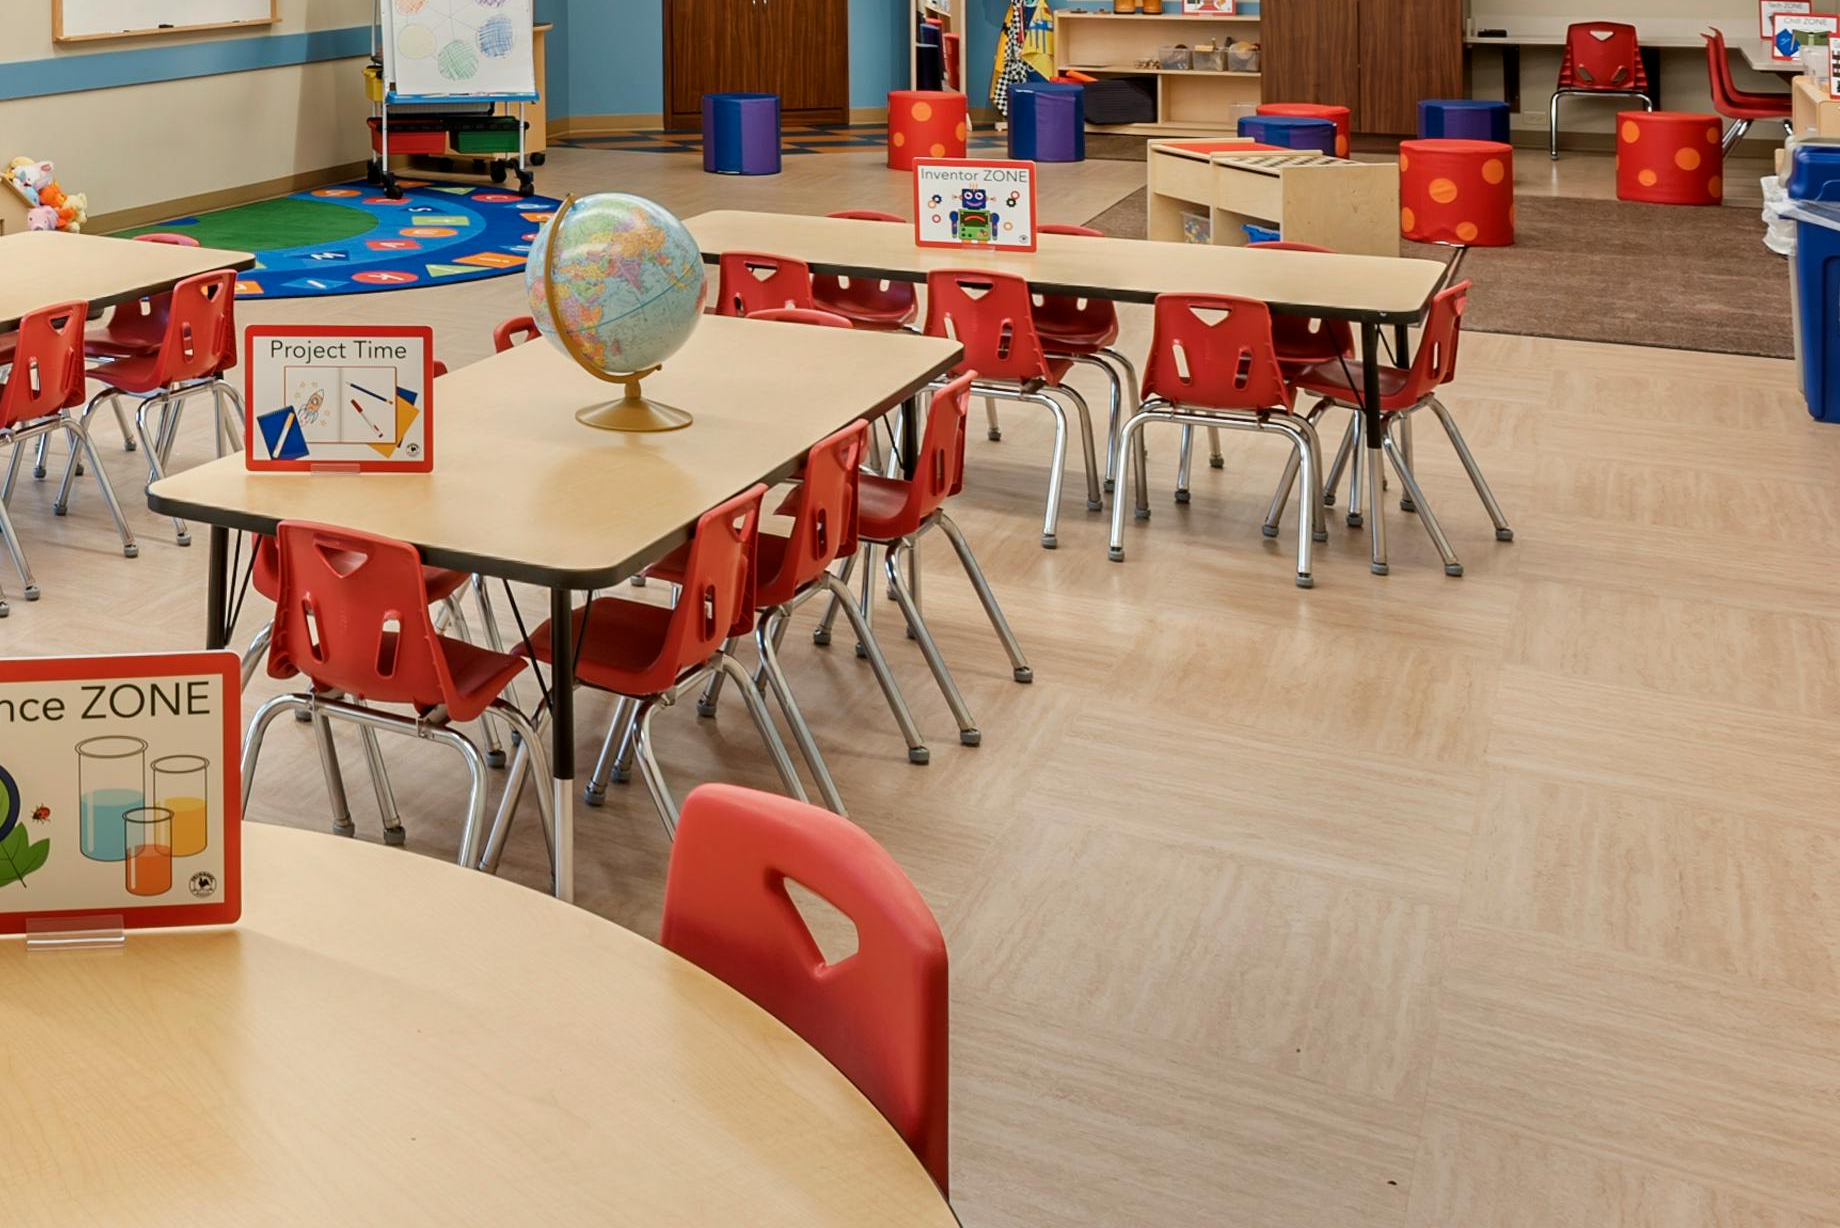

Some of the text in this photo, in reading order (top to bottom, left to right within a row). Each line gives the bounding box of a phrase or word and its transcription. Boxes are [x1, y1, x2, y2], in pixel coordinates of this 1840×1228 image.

[1803, 18, 1827, 26] ZONE
[920, 168, 1028, 183] Inventor ZONE
[270, 339, 407, 364] Project Time
[80, 680, 211, 721] ZONE
